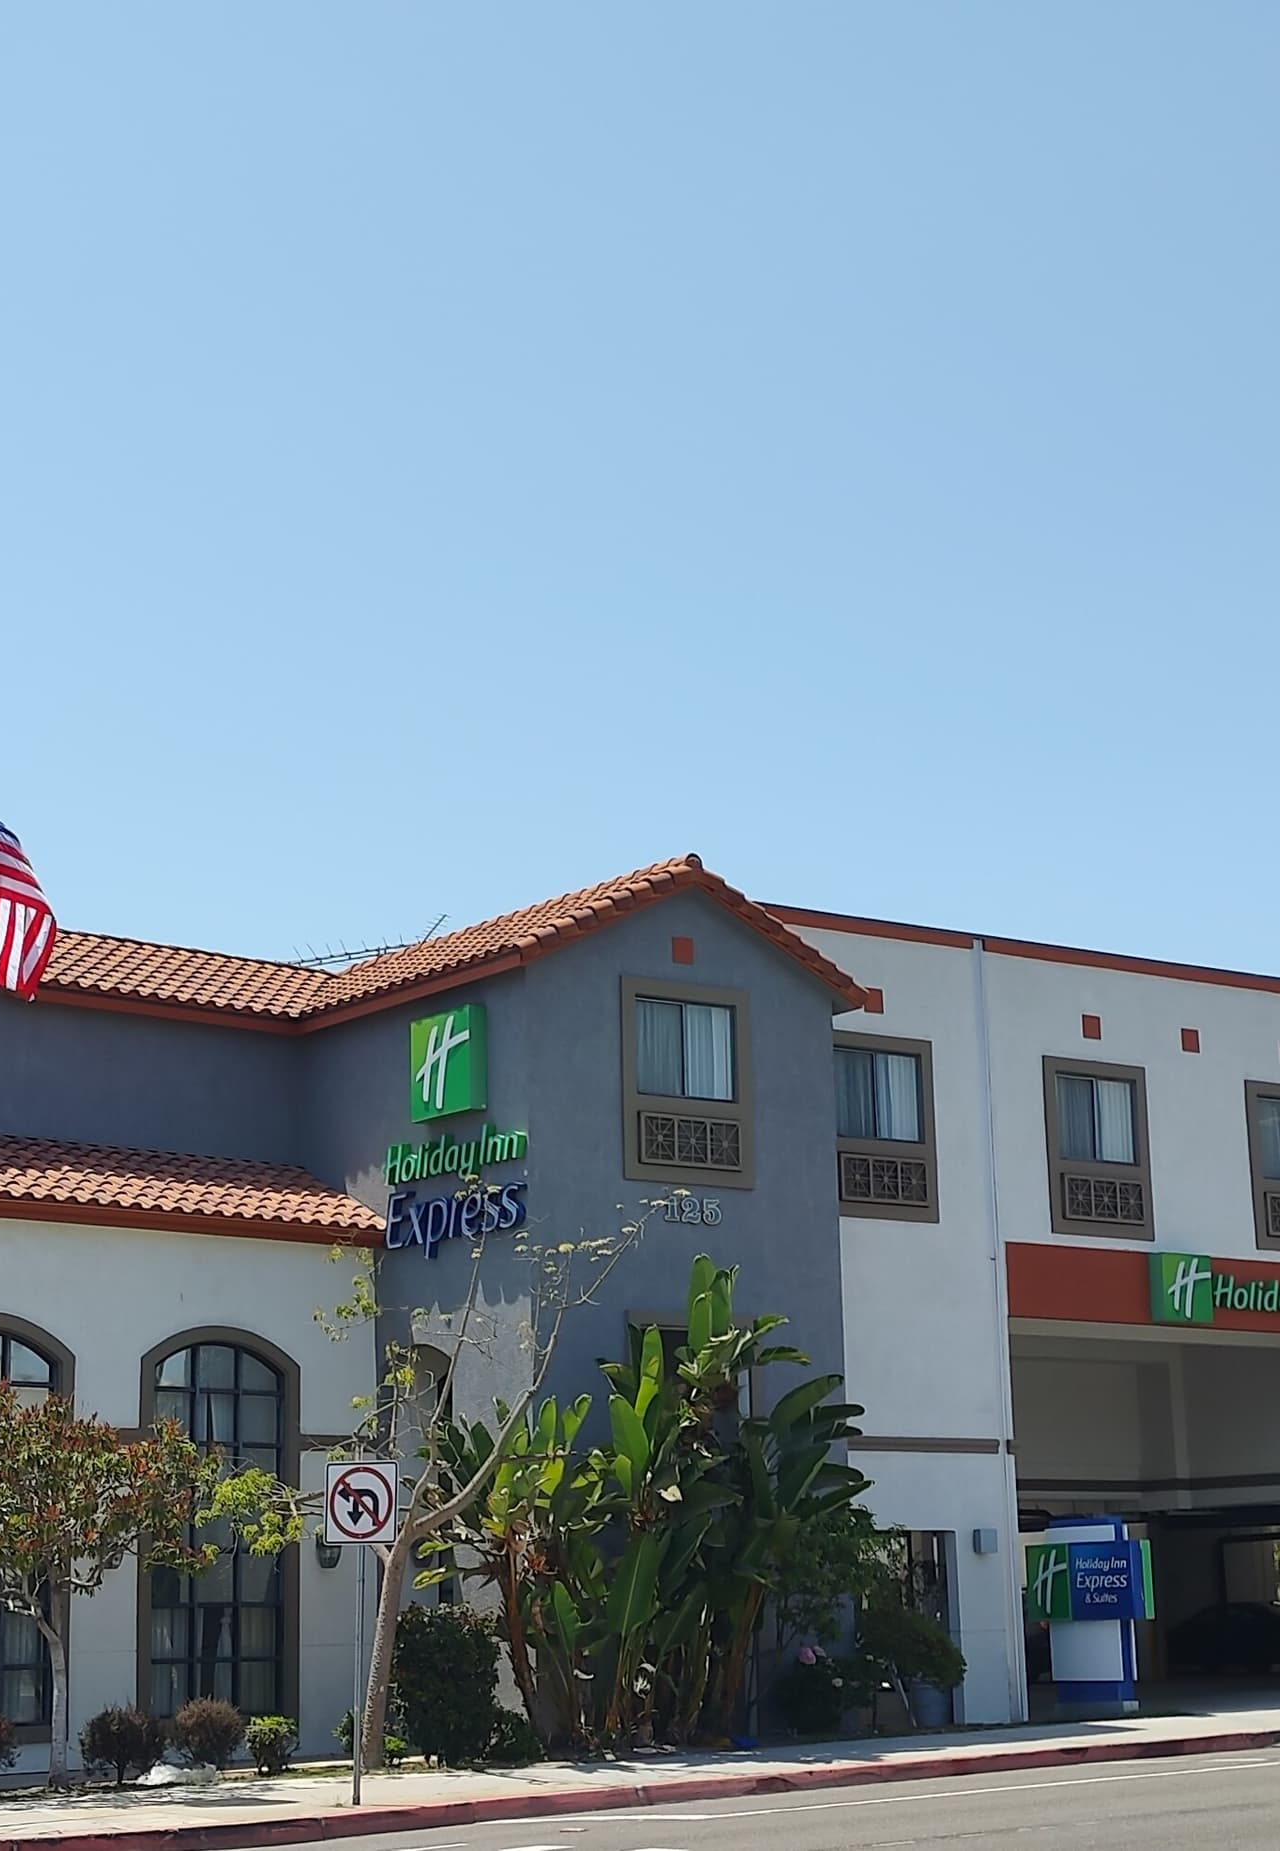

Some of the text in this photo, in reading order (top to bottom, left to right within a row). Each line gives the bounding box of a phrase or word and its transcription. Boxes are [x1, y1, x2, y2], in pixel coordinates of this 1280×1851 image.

[384, 1124, 526, 1187] Holiday Inn
[386, 1183, 524, 1260] Express
[664, 1196, 722, 1225] 125
[1075, 1557, 1127, 1572] Holiday Inn
[1076, 1572, 1128, 1592] Express
[1085, 1592, 1118, 1604] & Suites
